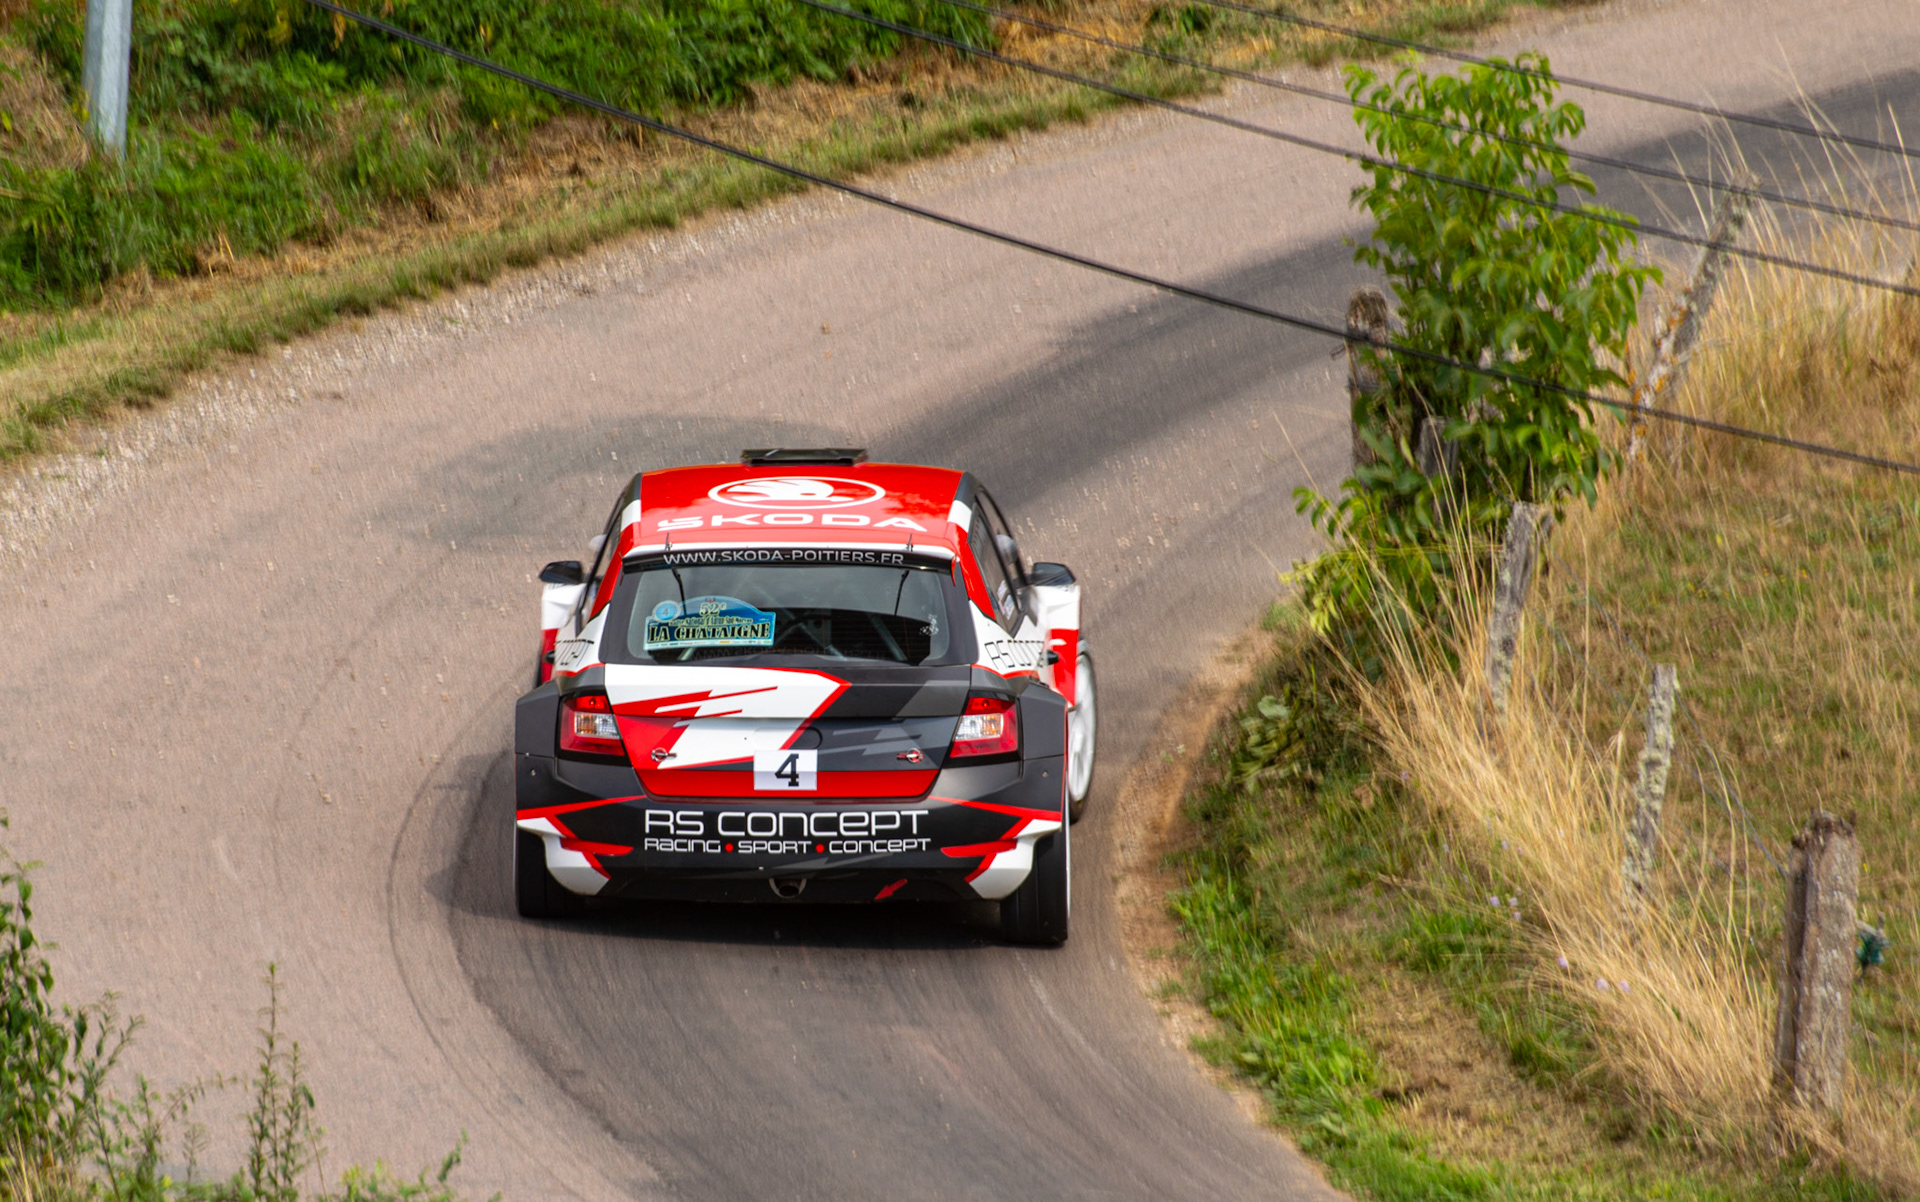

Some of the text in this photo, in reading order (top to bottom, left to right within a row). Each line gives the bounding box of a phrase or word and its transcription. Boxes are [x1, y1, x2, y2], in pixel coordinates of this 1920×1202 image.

[663, 550, 904, 564] WWW.SKODA-POITIERS.FR
[662, 607, 669, 616] 4
[649, 626, 670, 642] LA
[774, 753, 799, 787] 4
[645, 809, 704, 835] RS
[738, 840, 812, 854] SPORT
